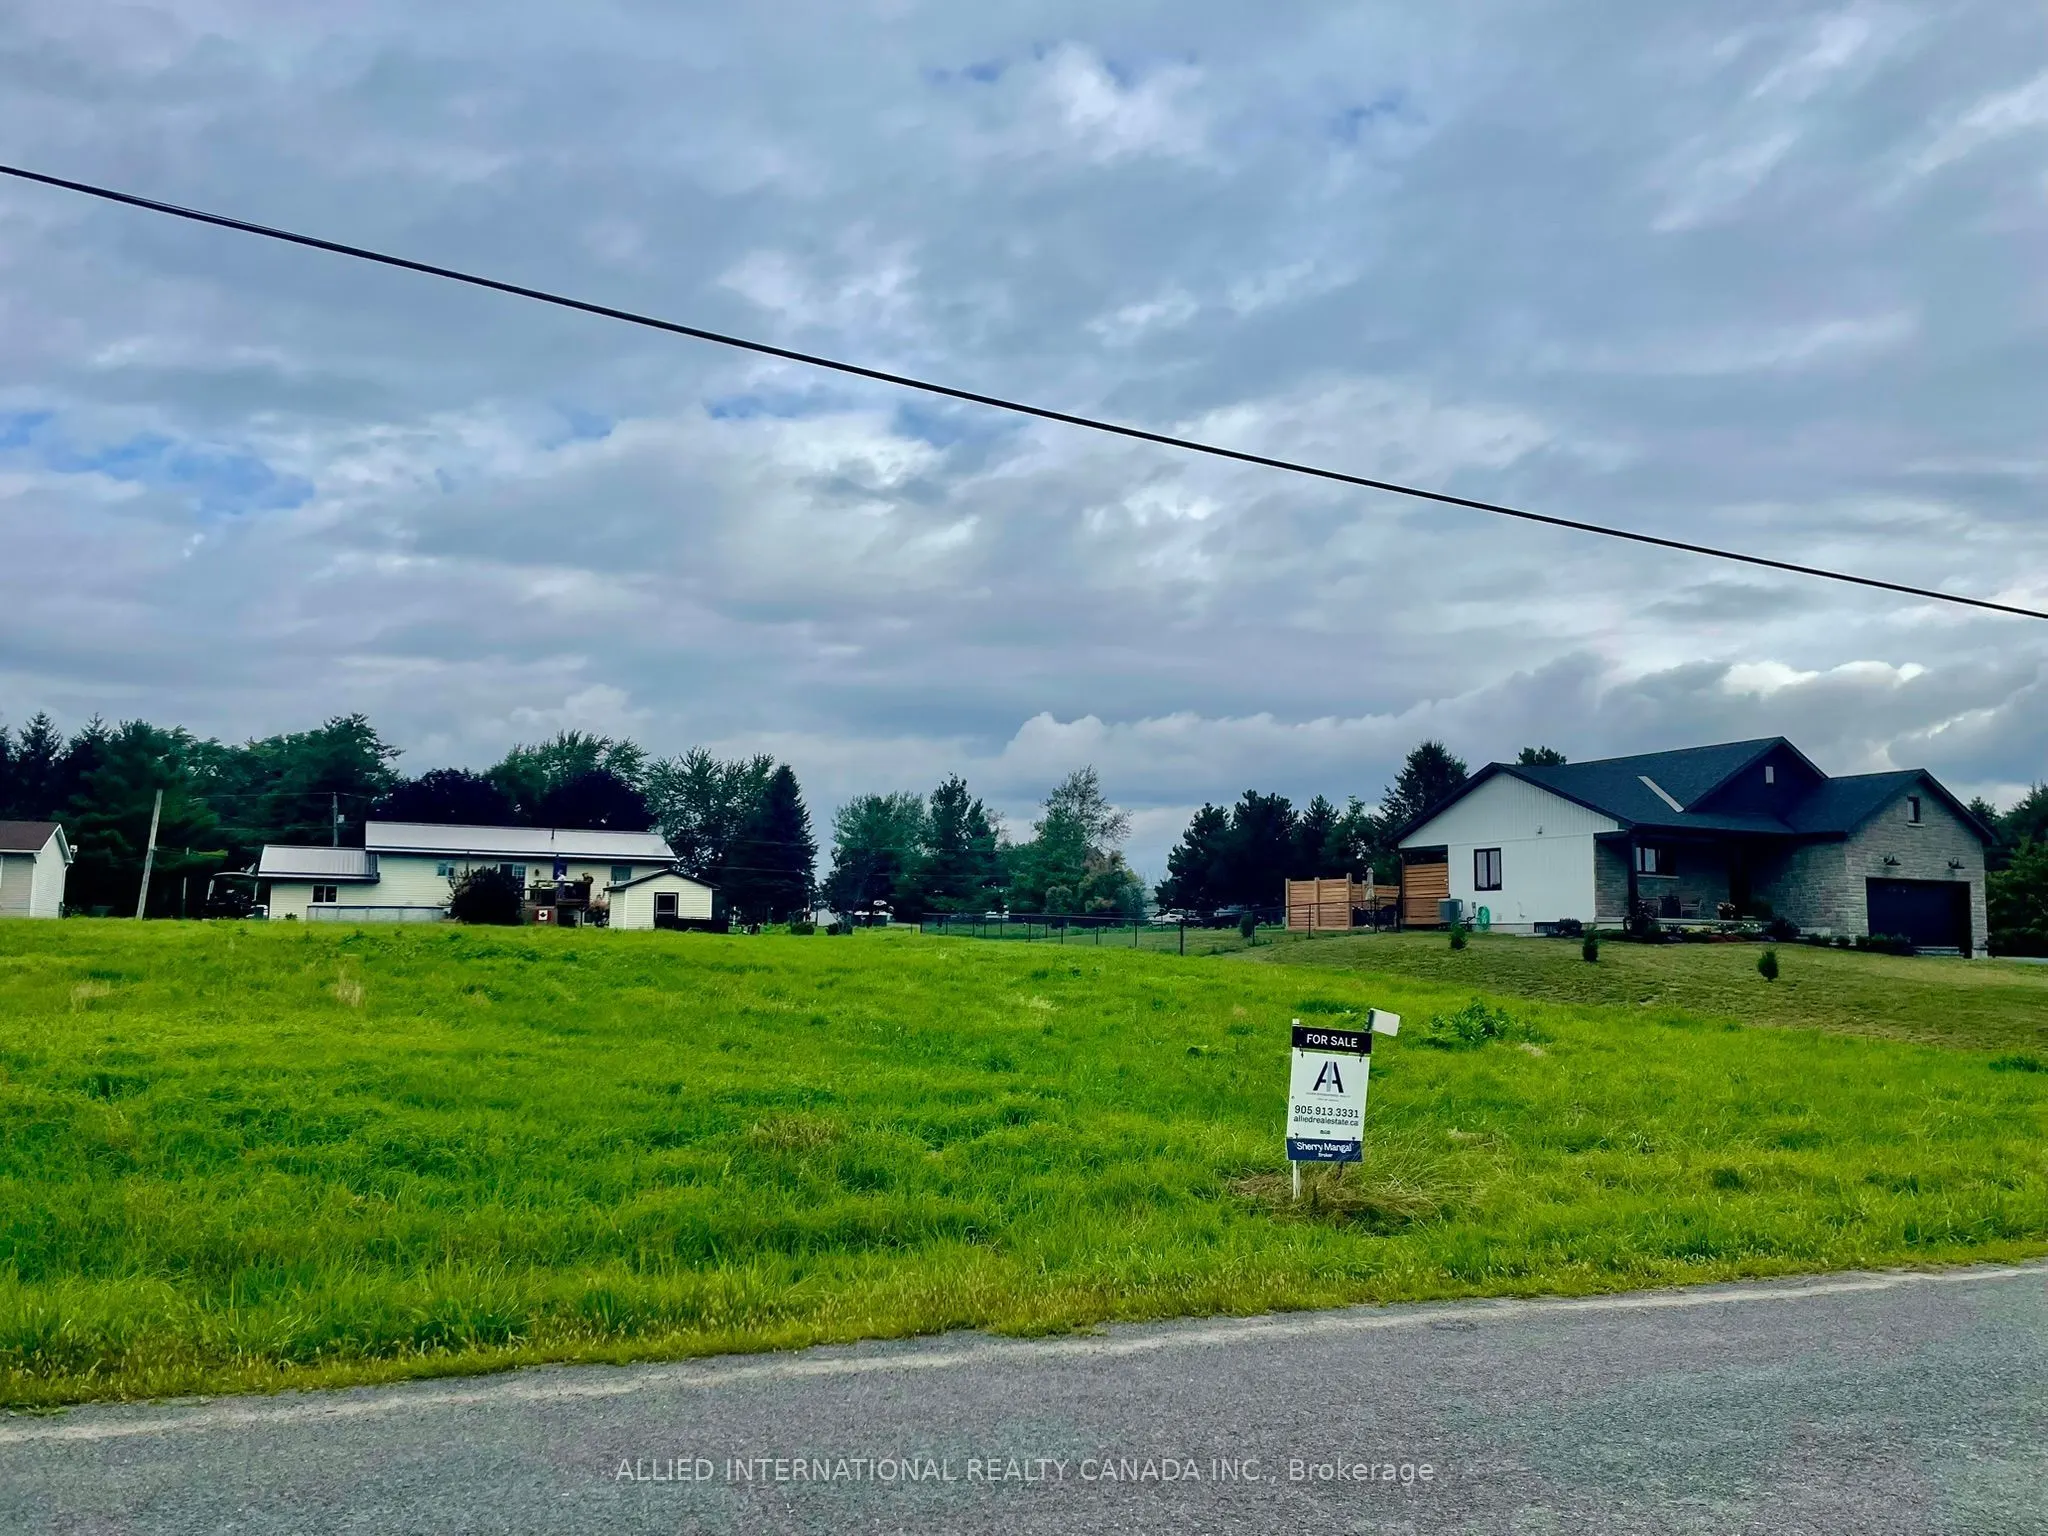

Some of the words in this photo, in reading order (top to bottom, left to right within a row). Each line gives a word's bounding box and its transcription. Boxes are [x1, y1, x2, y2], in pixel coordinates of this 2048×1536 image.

[1306, 1033, 1328, 1046] FOR
[1330, 1036, 1358, 1048] SALE
[1294, 1104, 1359, 1118] 905.913.3331
[1293, 1115, 1359, 1127] alliedrealestate.ca
[1296, 1141, 1323, 1152] Sherry
[1324, 1142, 1352, 1154] Mangal
